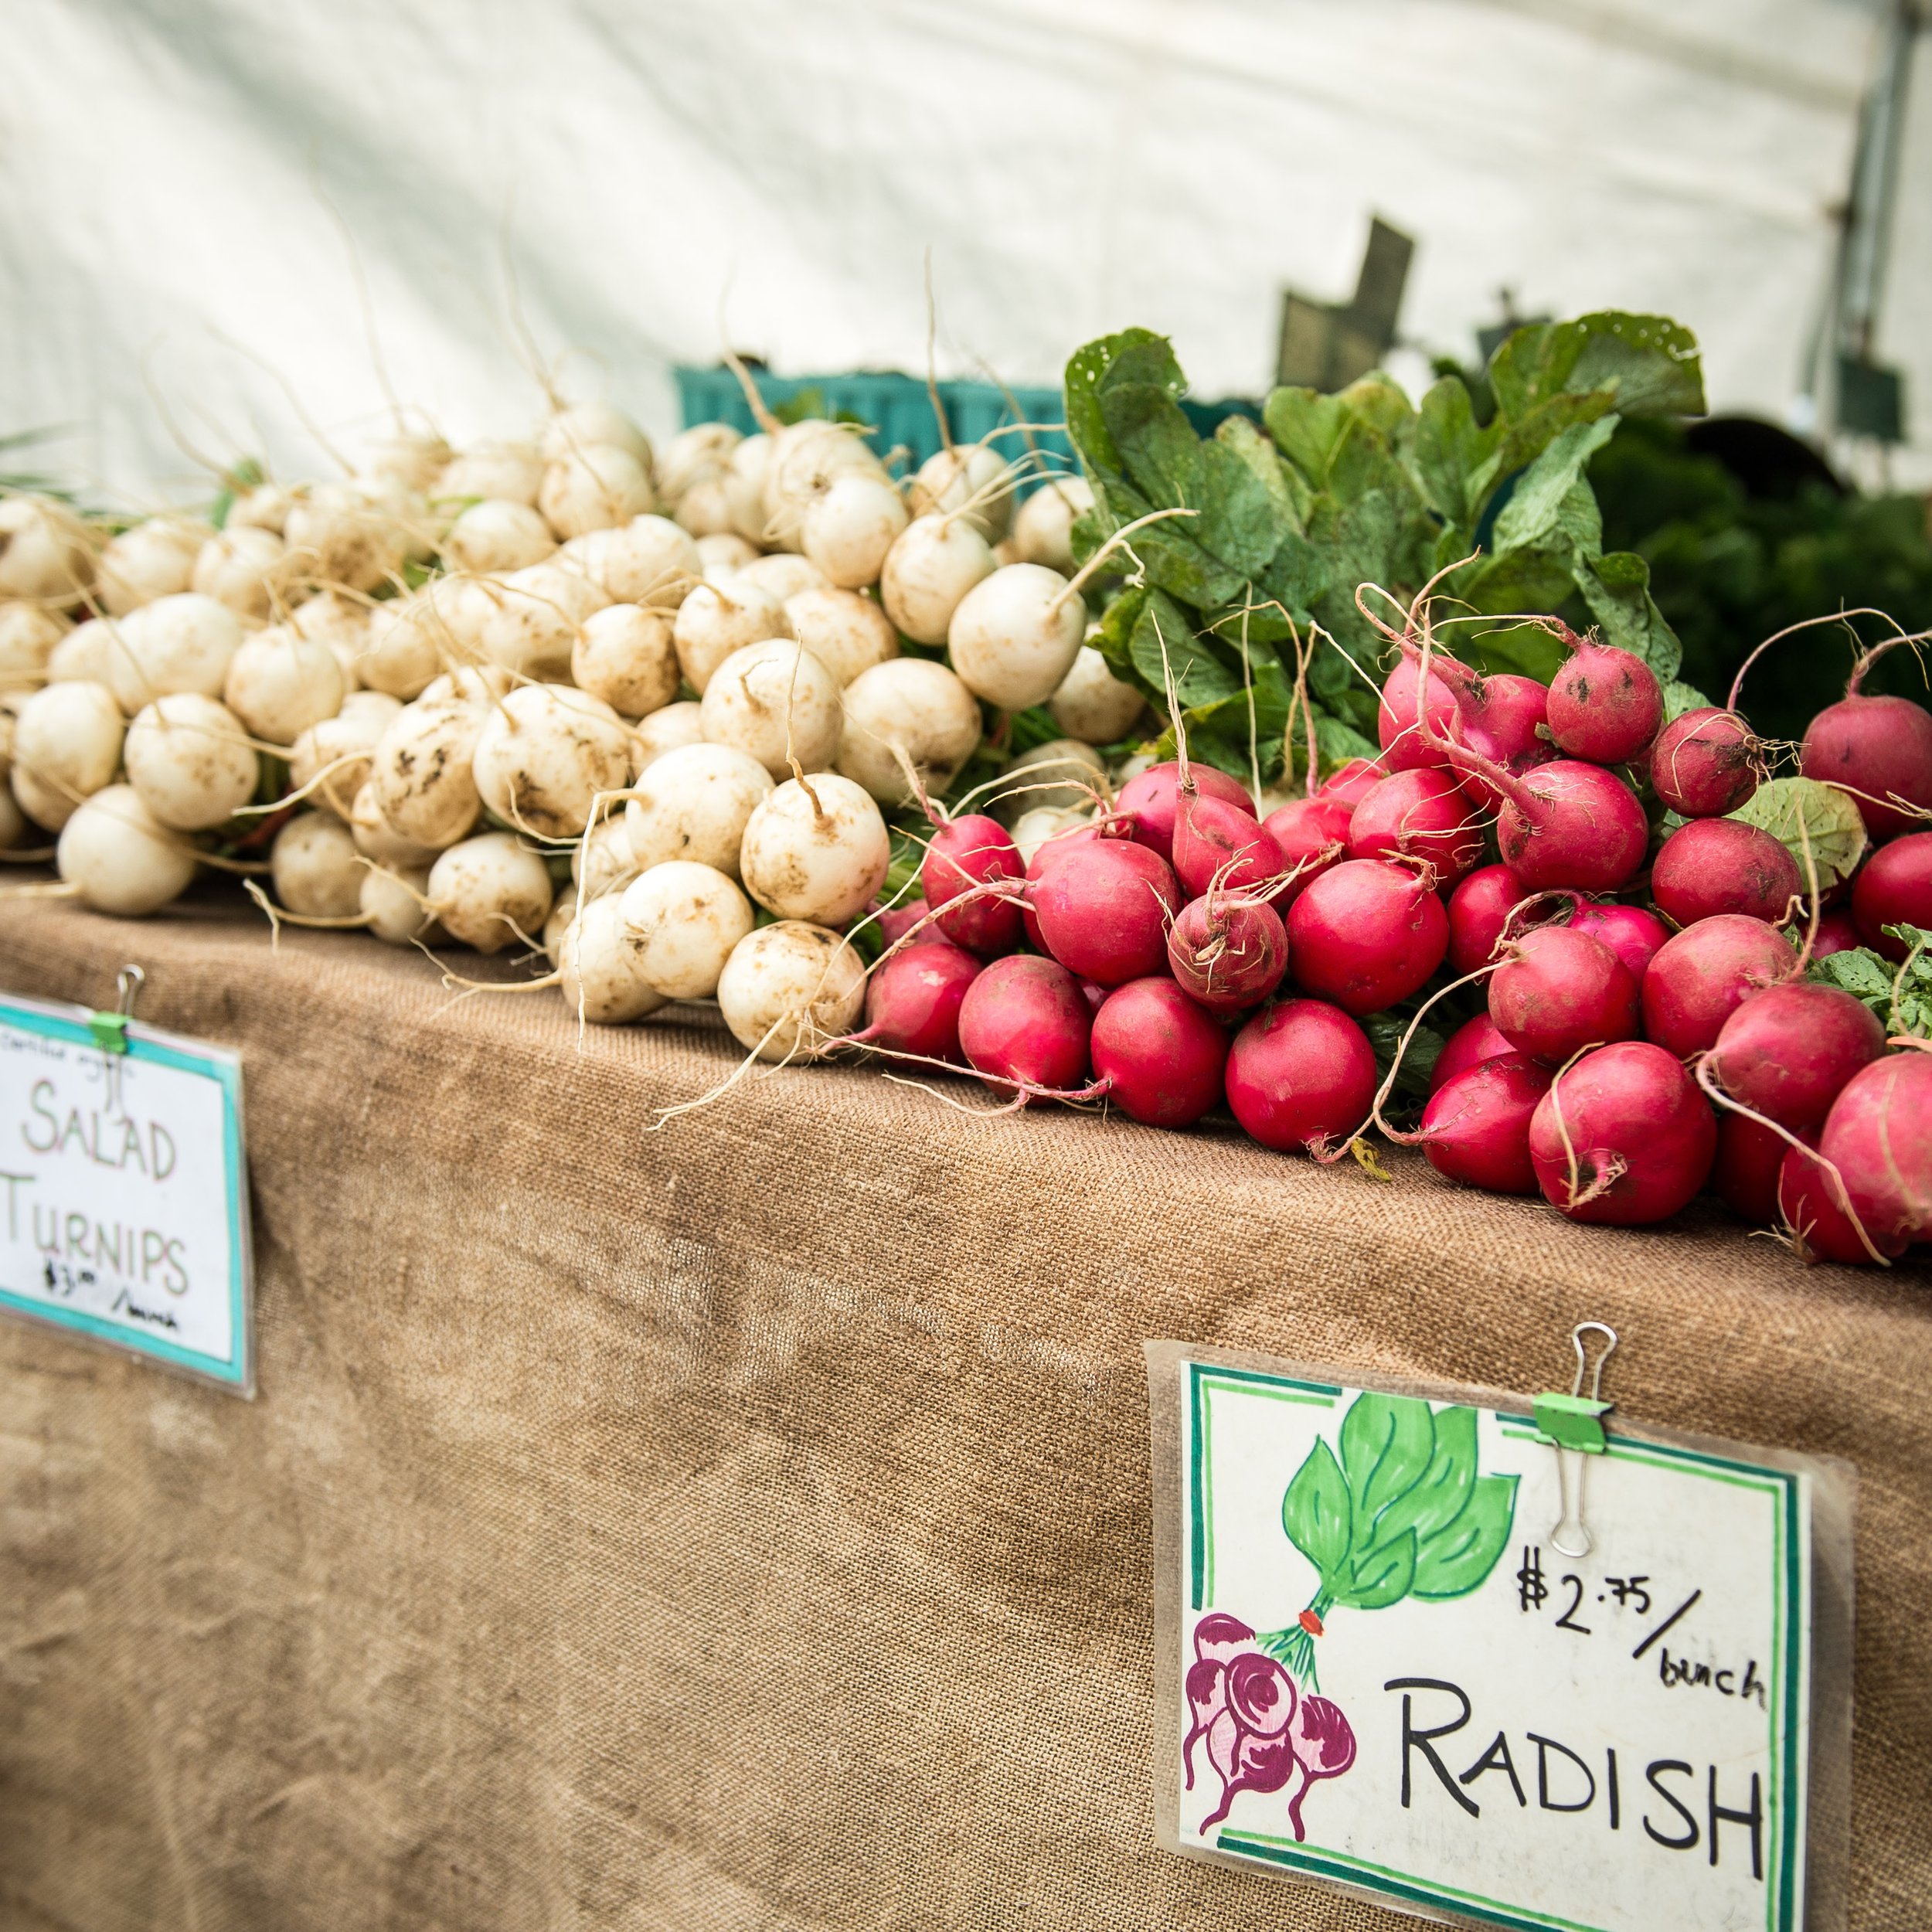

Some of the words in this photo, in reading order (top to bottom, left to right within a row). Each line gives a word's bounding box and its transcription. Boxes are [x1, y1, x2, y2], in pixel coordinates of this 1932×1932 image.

[22, 1080, 176, 1181] SALAD
[0, 1172, 189, 1297] TURNIPS
[1661, 1648, 1767, 1711] bunch
[1385, 1679, 1763, 1880] RADISH
